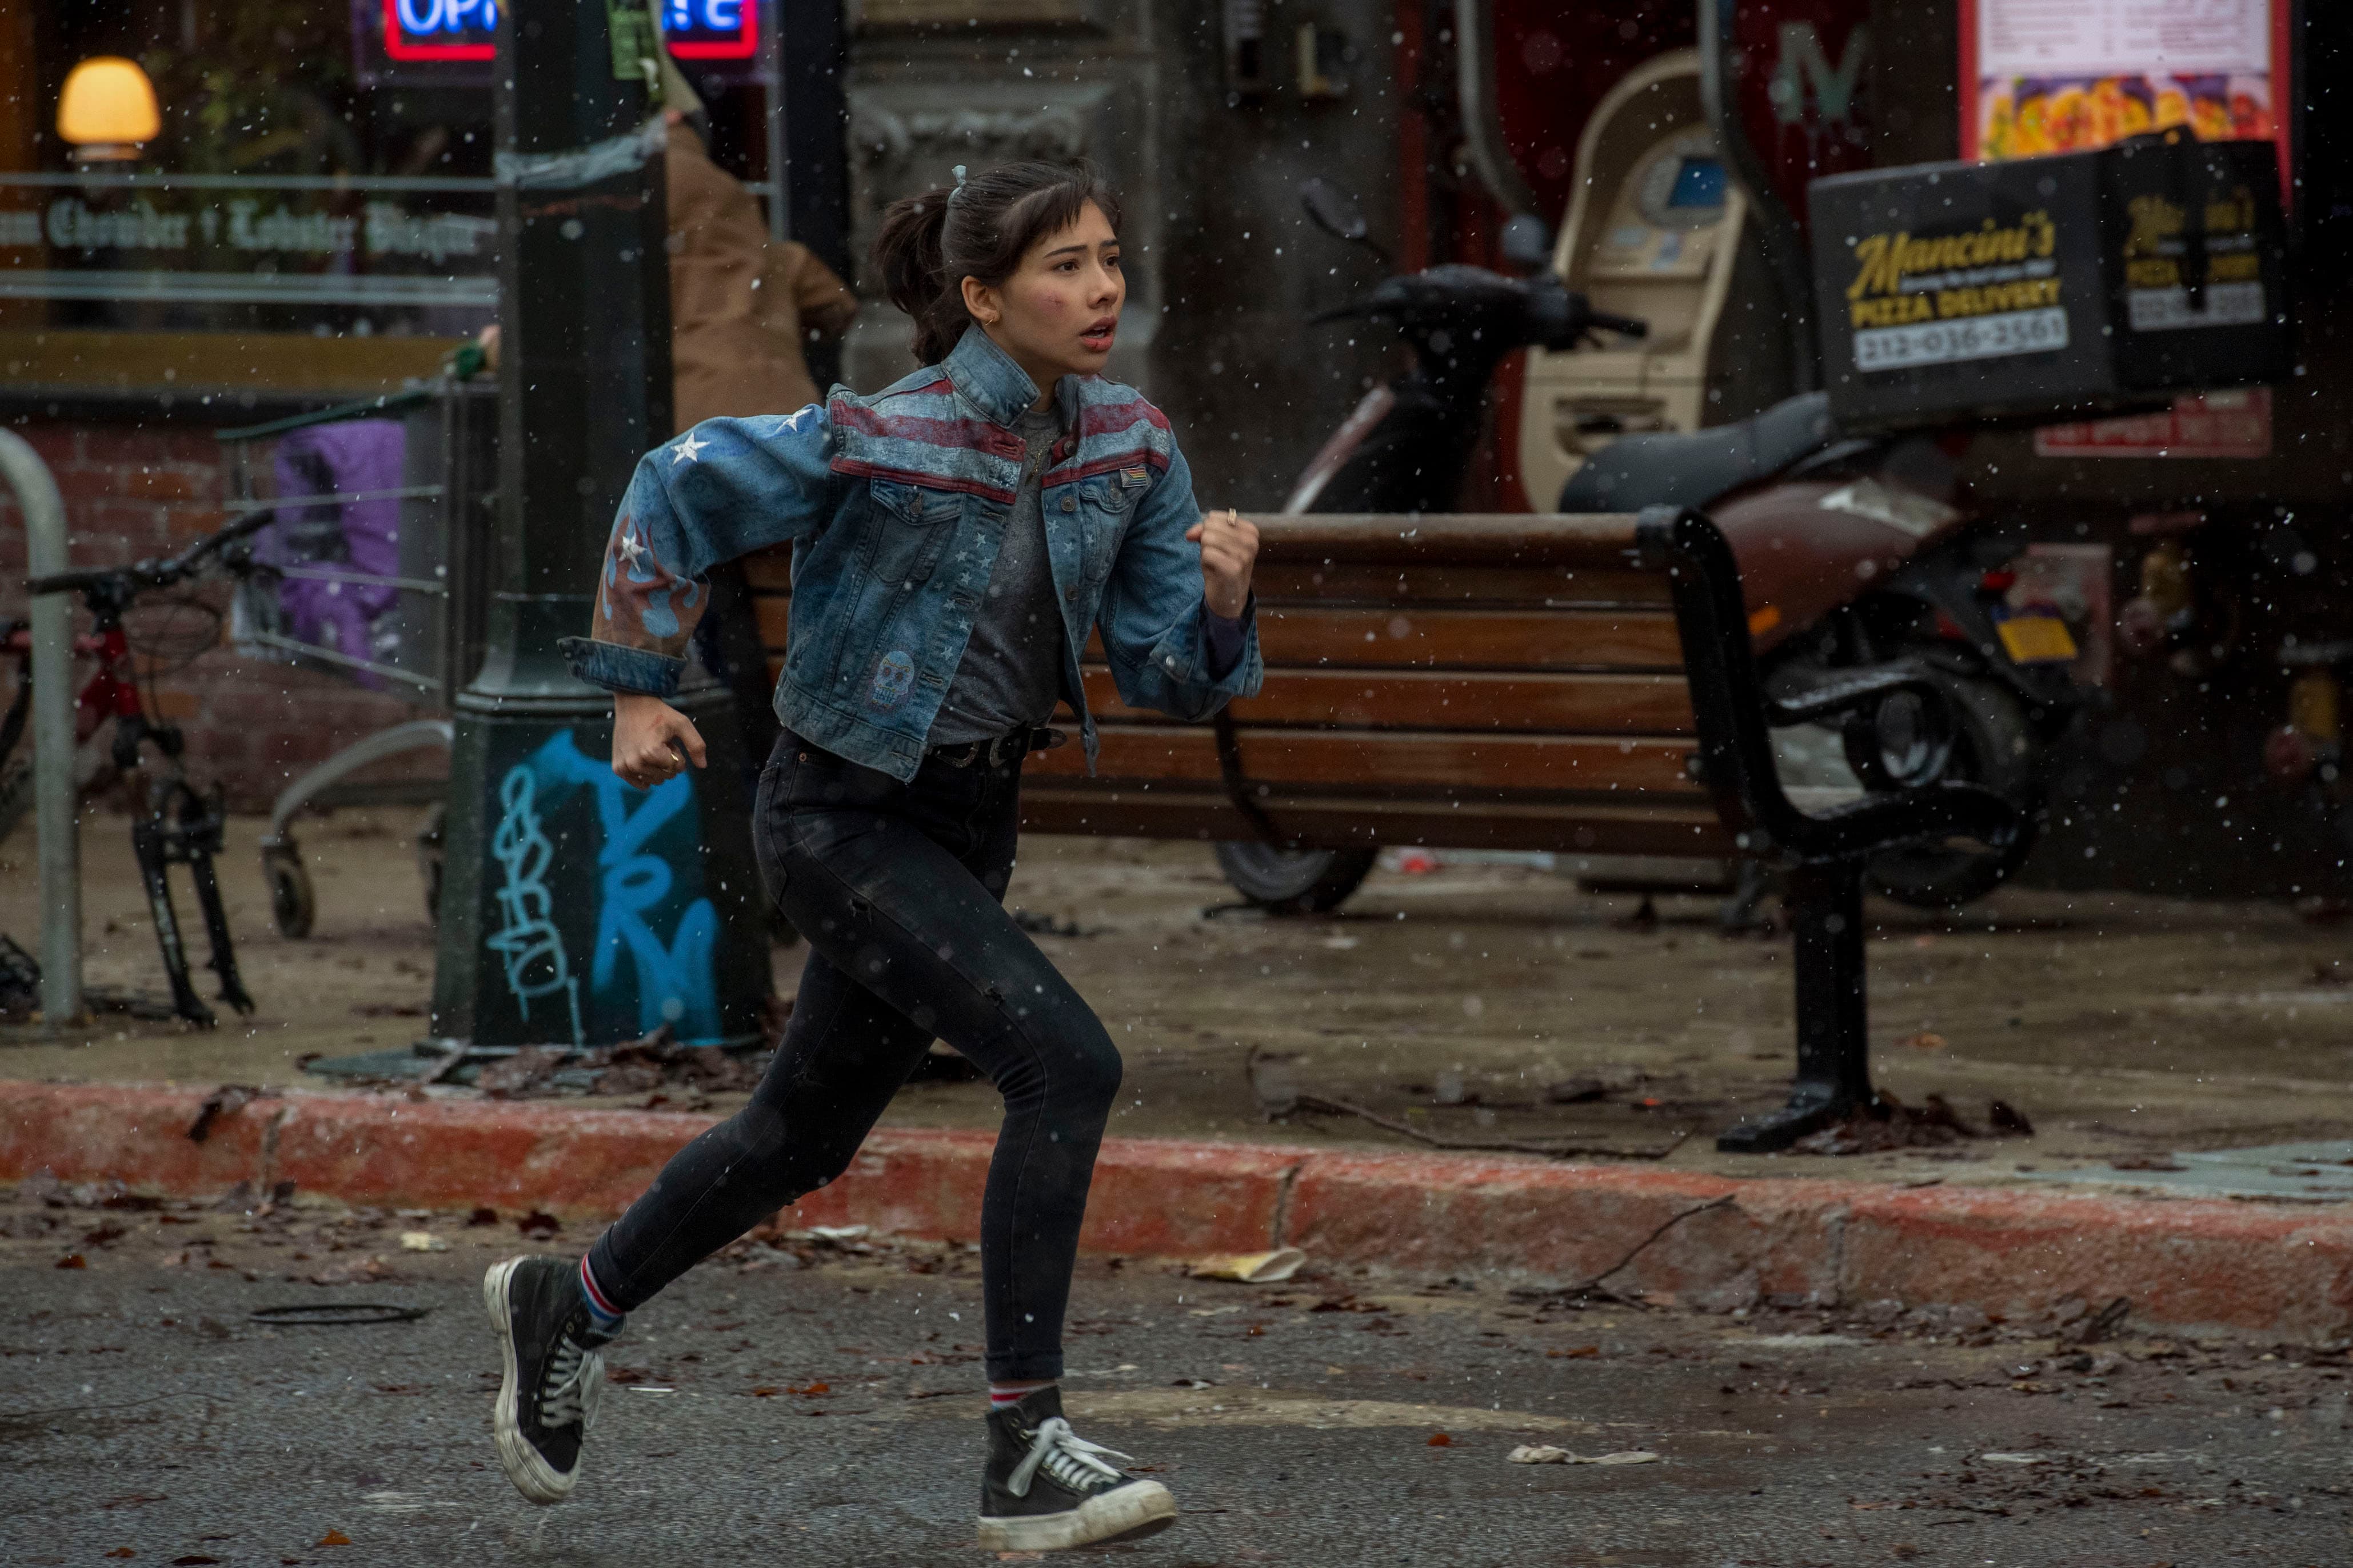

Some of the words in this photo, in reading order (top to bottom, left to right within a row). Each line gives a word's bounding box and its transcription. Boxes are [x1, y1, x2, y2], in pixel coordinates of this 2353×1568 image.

[1847, 209, 2055, 299] Mancini's
[1851, 293, 1934, 329] PIZZA
[1936, 278, 2061, 319] DELIVERY
